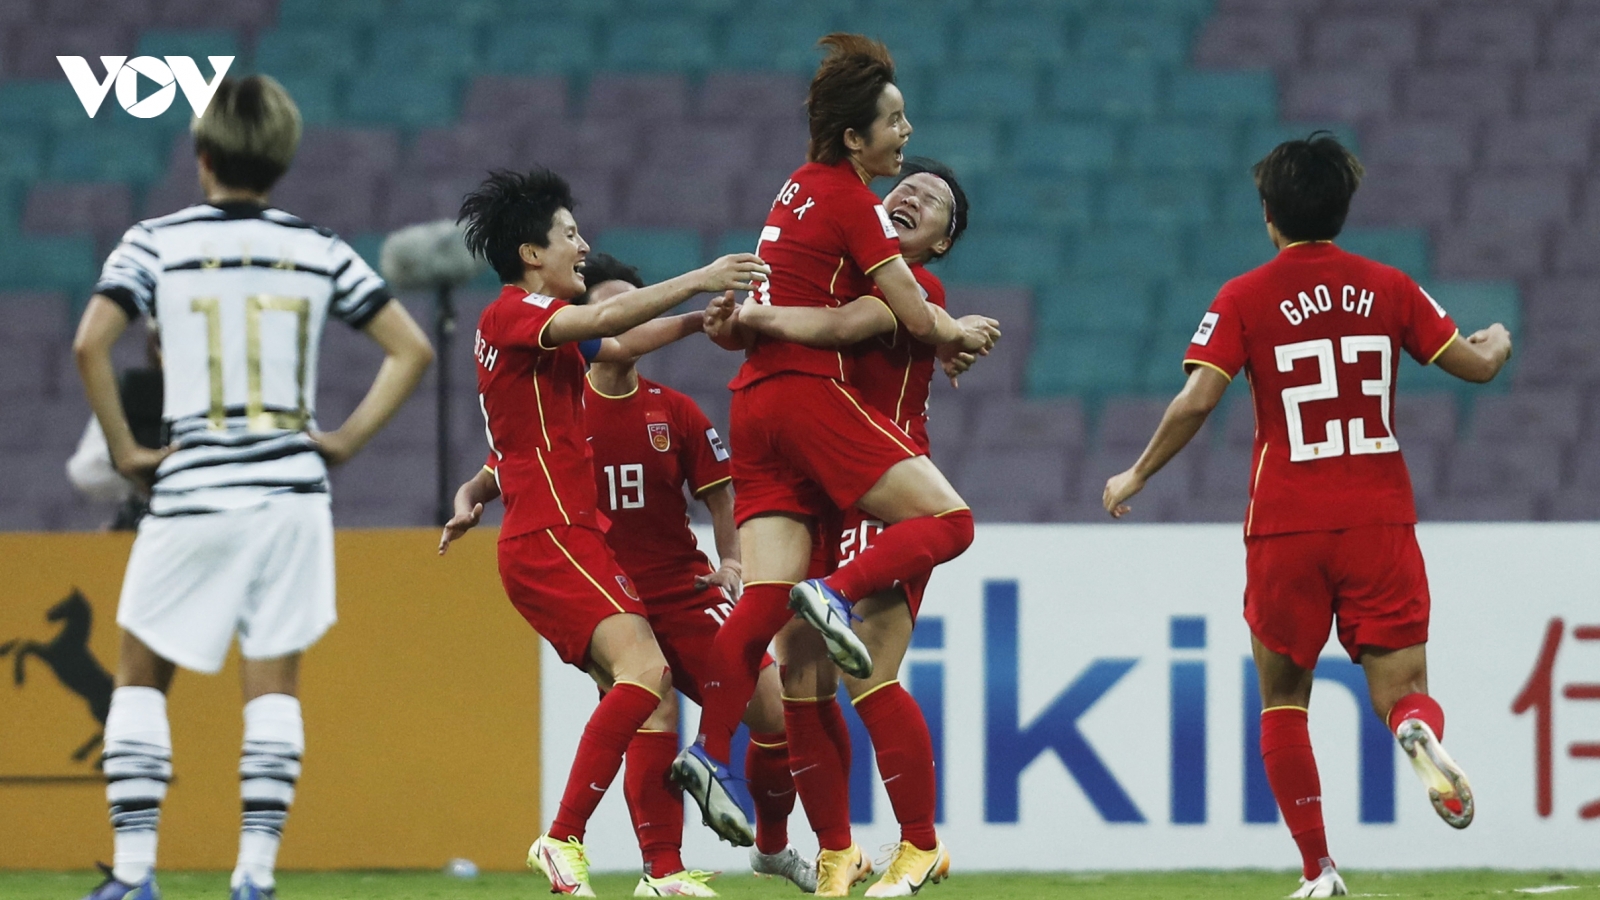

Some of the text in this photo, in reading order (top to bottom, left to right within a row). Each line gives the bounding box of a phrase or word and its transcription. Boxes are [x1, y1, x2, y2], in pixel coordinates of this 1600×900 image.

[793, 196, 816, 220] X
[1279, 284, 1375, 326] GAO CH
[190, 295, 310, 432] 10
[1274, 335, 1400, 462] 23
[603, 463, 645, 511] 19
